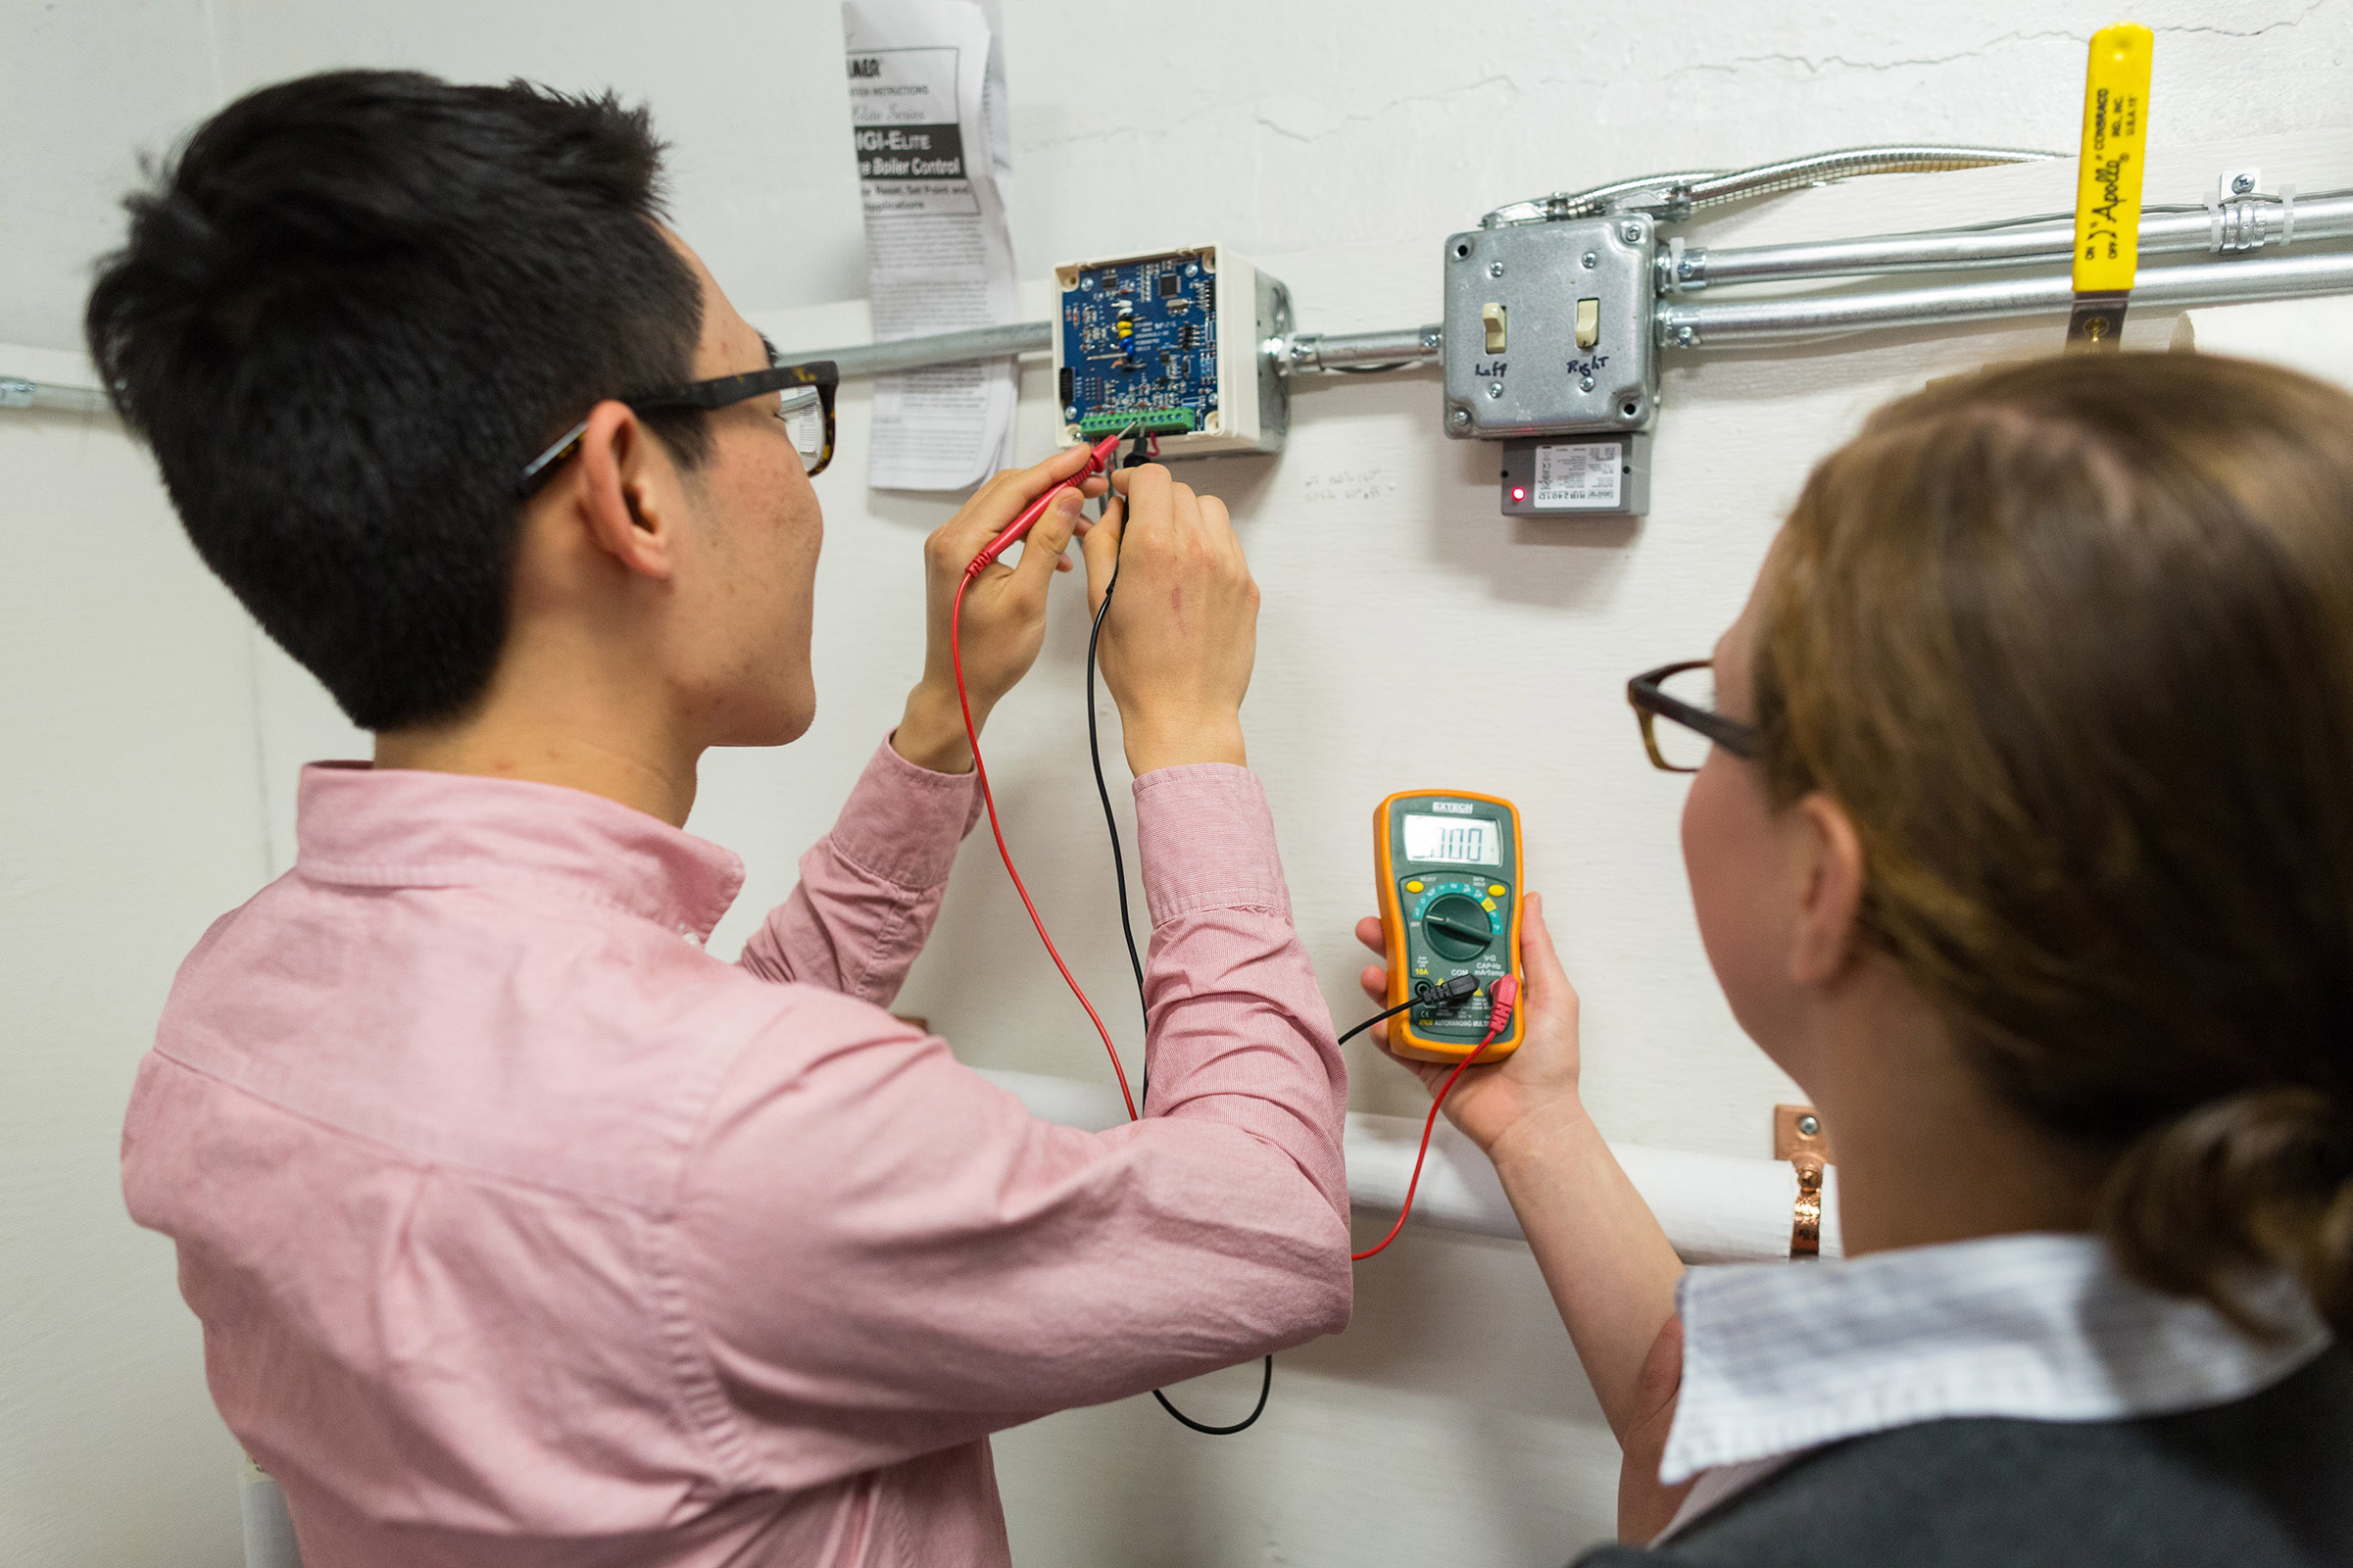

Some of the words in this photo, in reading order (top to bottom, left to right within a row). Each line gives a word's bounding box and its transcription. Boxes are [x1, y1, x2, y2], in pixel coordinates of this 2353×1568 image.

[872, 157, 910, 174] Boiler
[910, 157, 960, 175] Control
[1432, 802, 1474, 814] EXTECH
